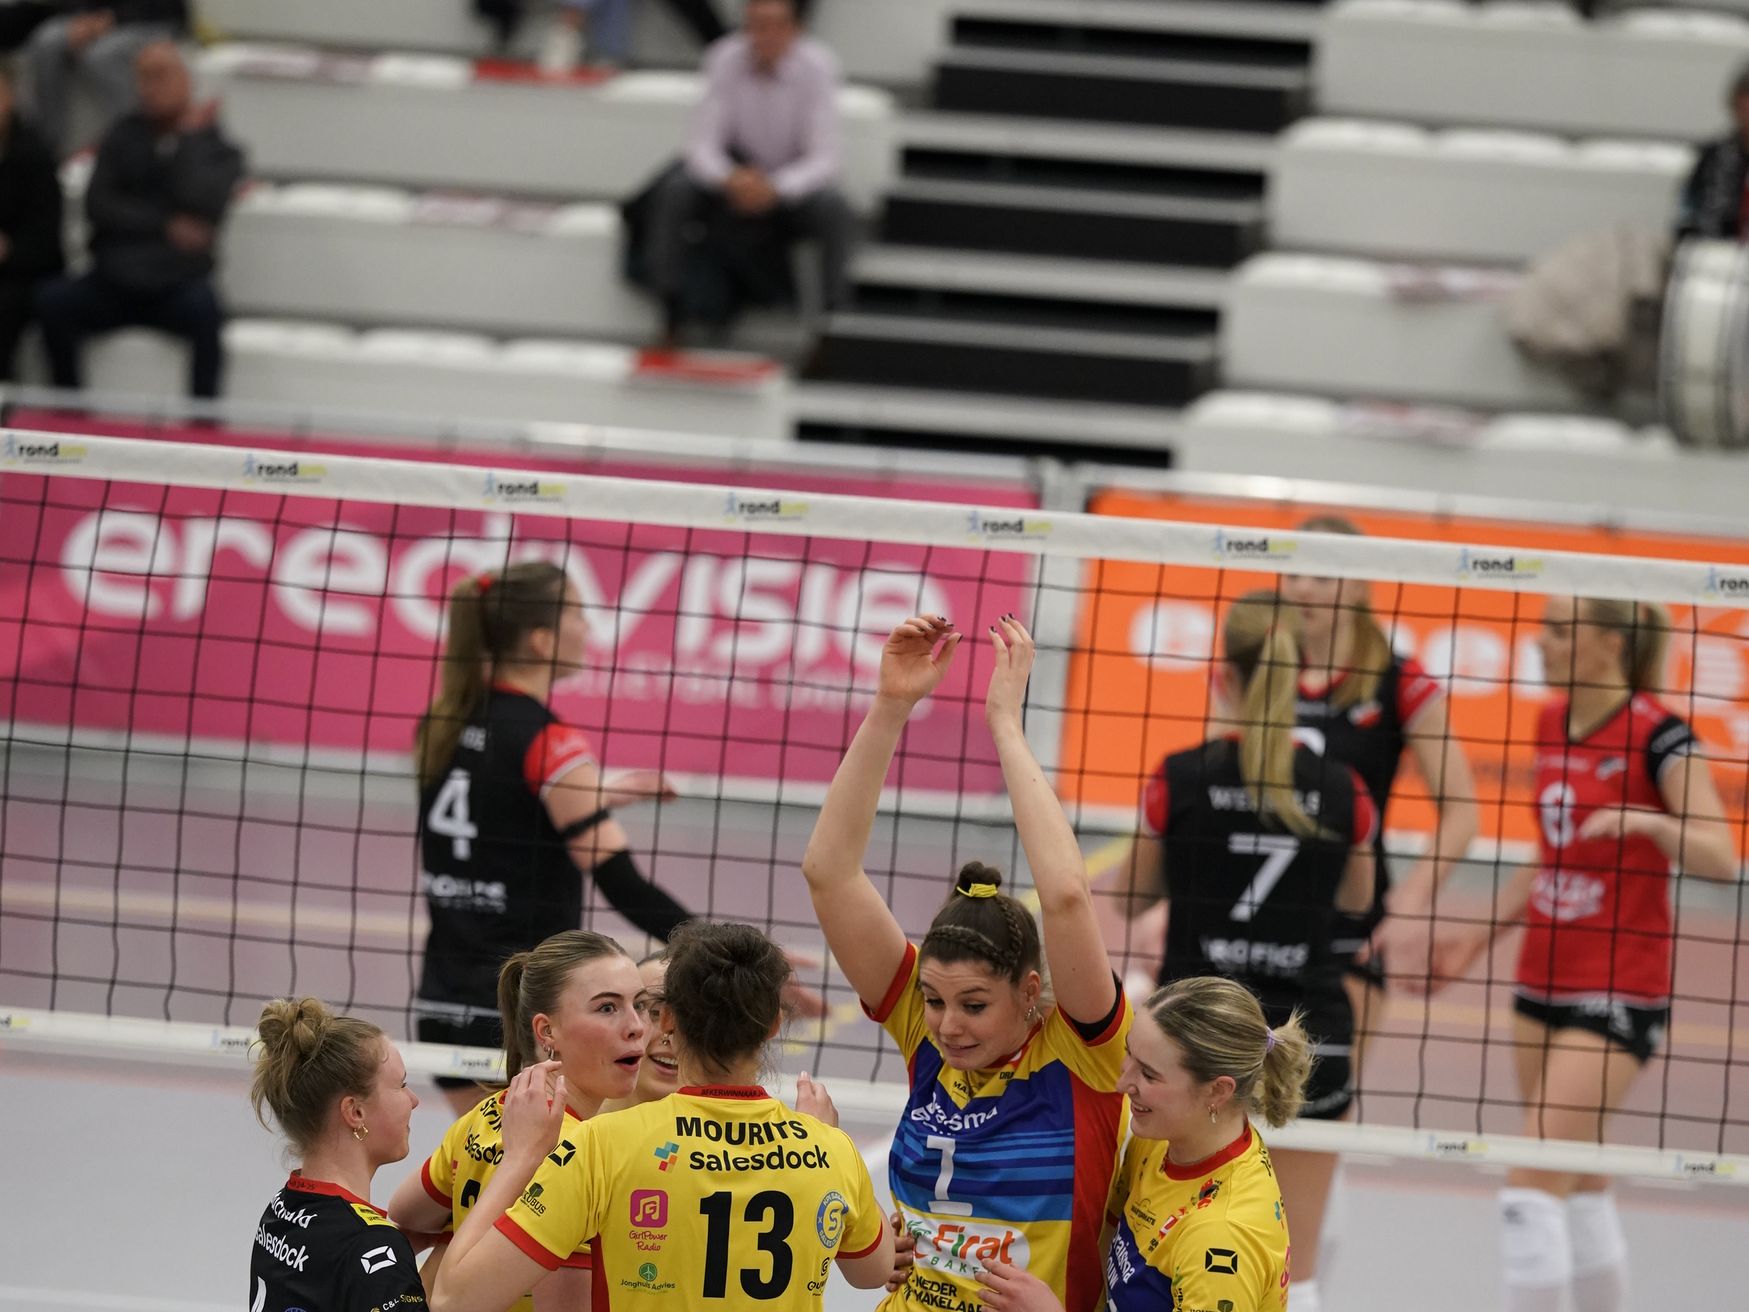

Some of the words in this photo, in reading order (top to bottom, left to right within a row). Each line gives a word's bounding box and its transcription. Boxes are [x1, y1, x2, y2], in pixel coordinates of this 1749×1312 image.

[61, 505, 955, 668] eredvisie
[427, 767, 478, 859] 4
[1228, 831, 1299, 922] 7
[676, 1116, 808, 1145] MOURITS
[689, 1145, 830, 1172] salesdock
[629, 1230, 668, 1242] GirlPower
[636, 1242, 662, 1252] Radio
[699, 1190, 795, 1300] 13
[932, 1222, 1016, 1265] Firat
[620, 1279, 651, 1289] Jonghuis
